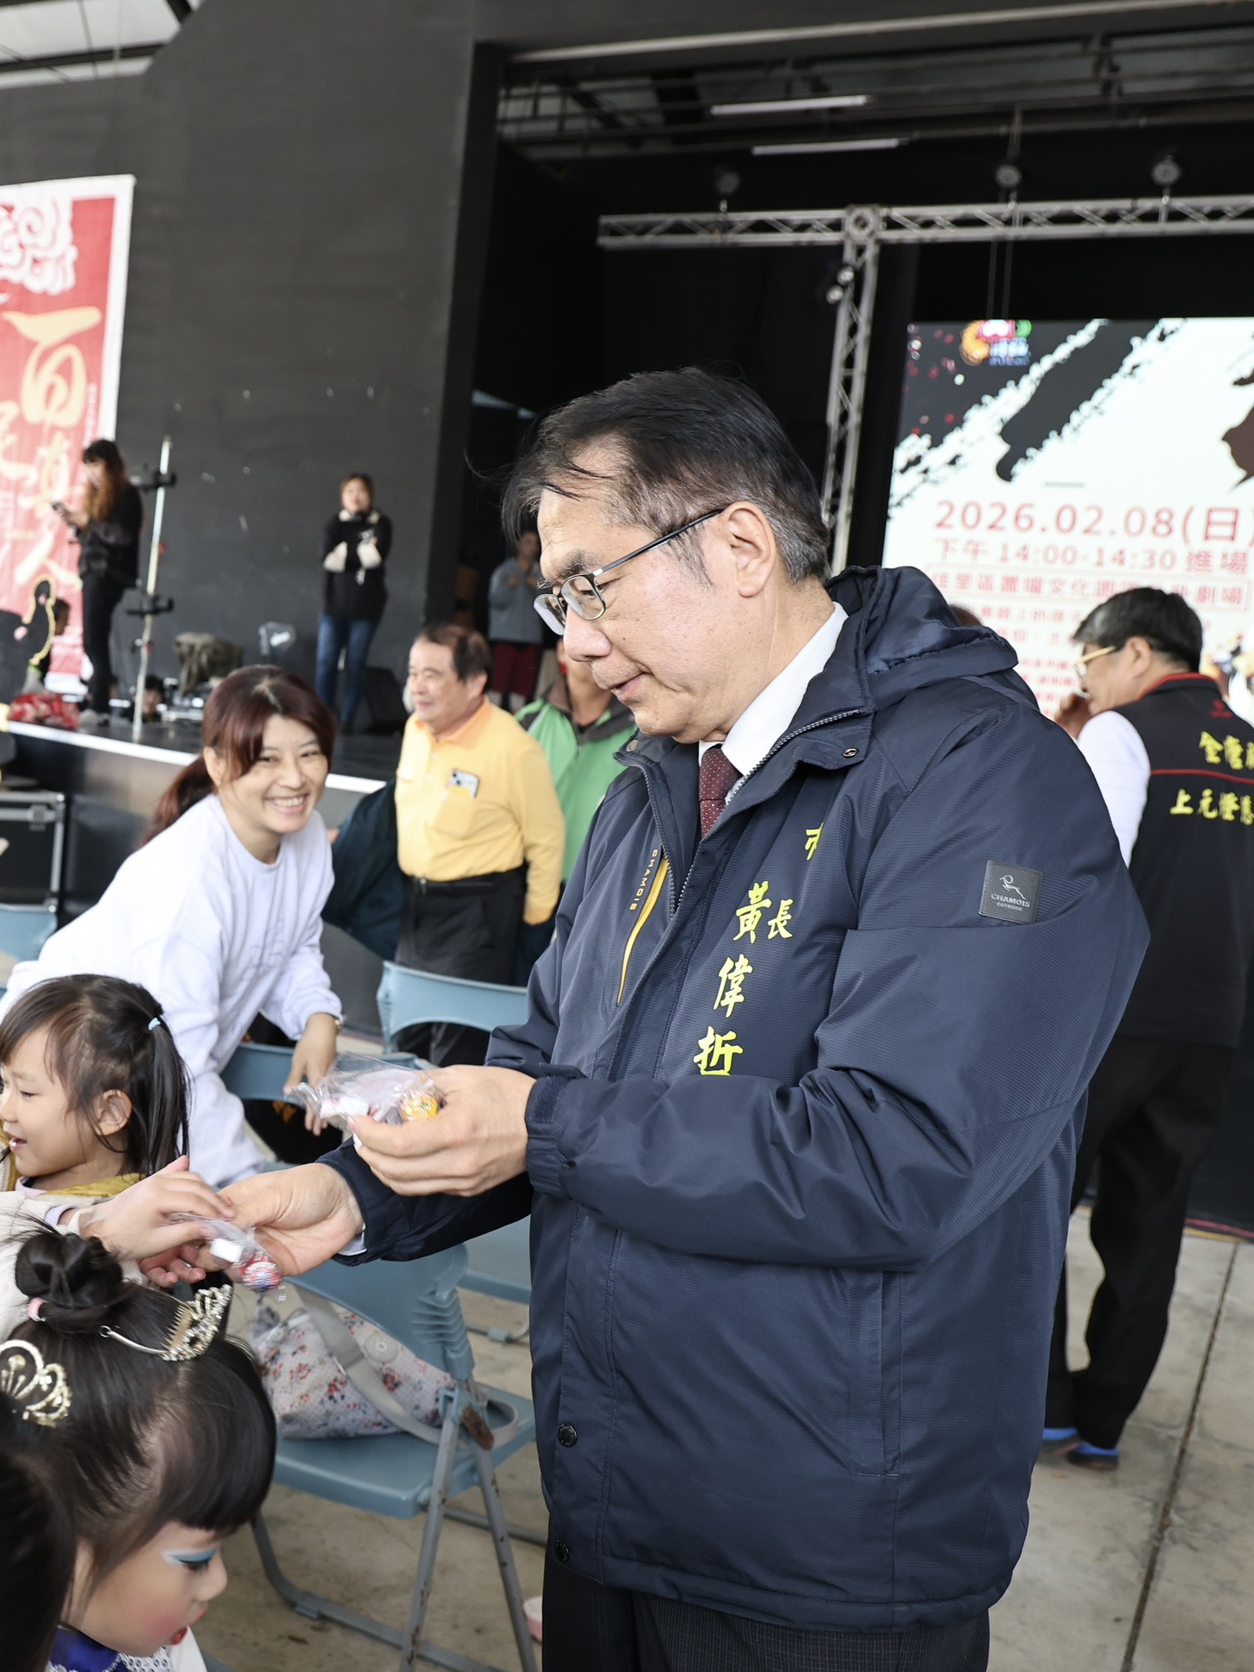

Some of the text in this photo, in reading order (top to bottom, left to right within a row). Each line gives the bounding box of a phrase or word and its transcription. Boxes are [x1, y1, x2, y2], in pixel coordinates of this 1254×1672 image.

[935, 537, 1248, 576] 下午 14:00-14:30 進場
[629, 848, 659, 911] CHAMOIS
[990, 893, 1031, 908] CHAMOIS
